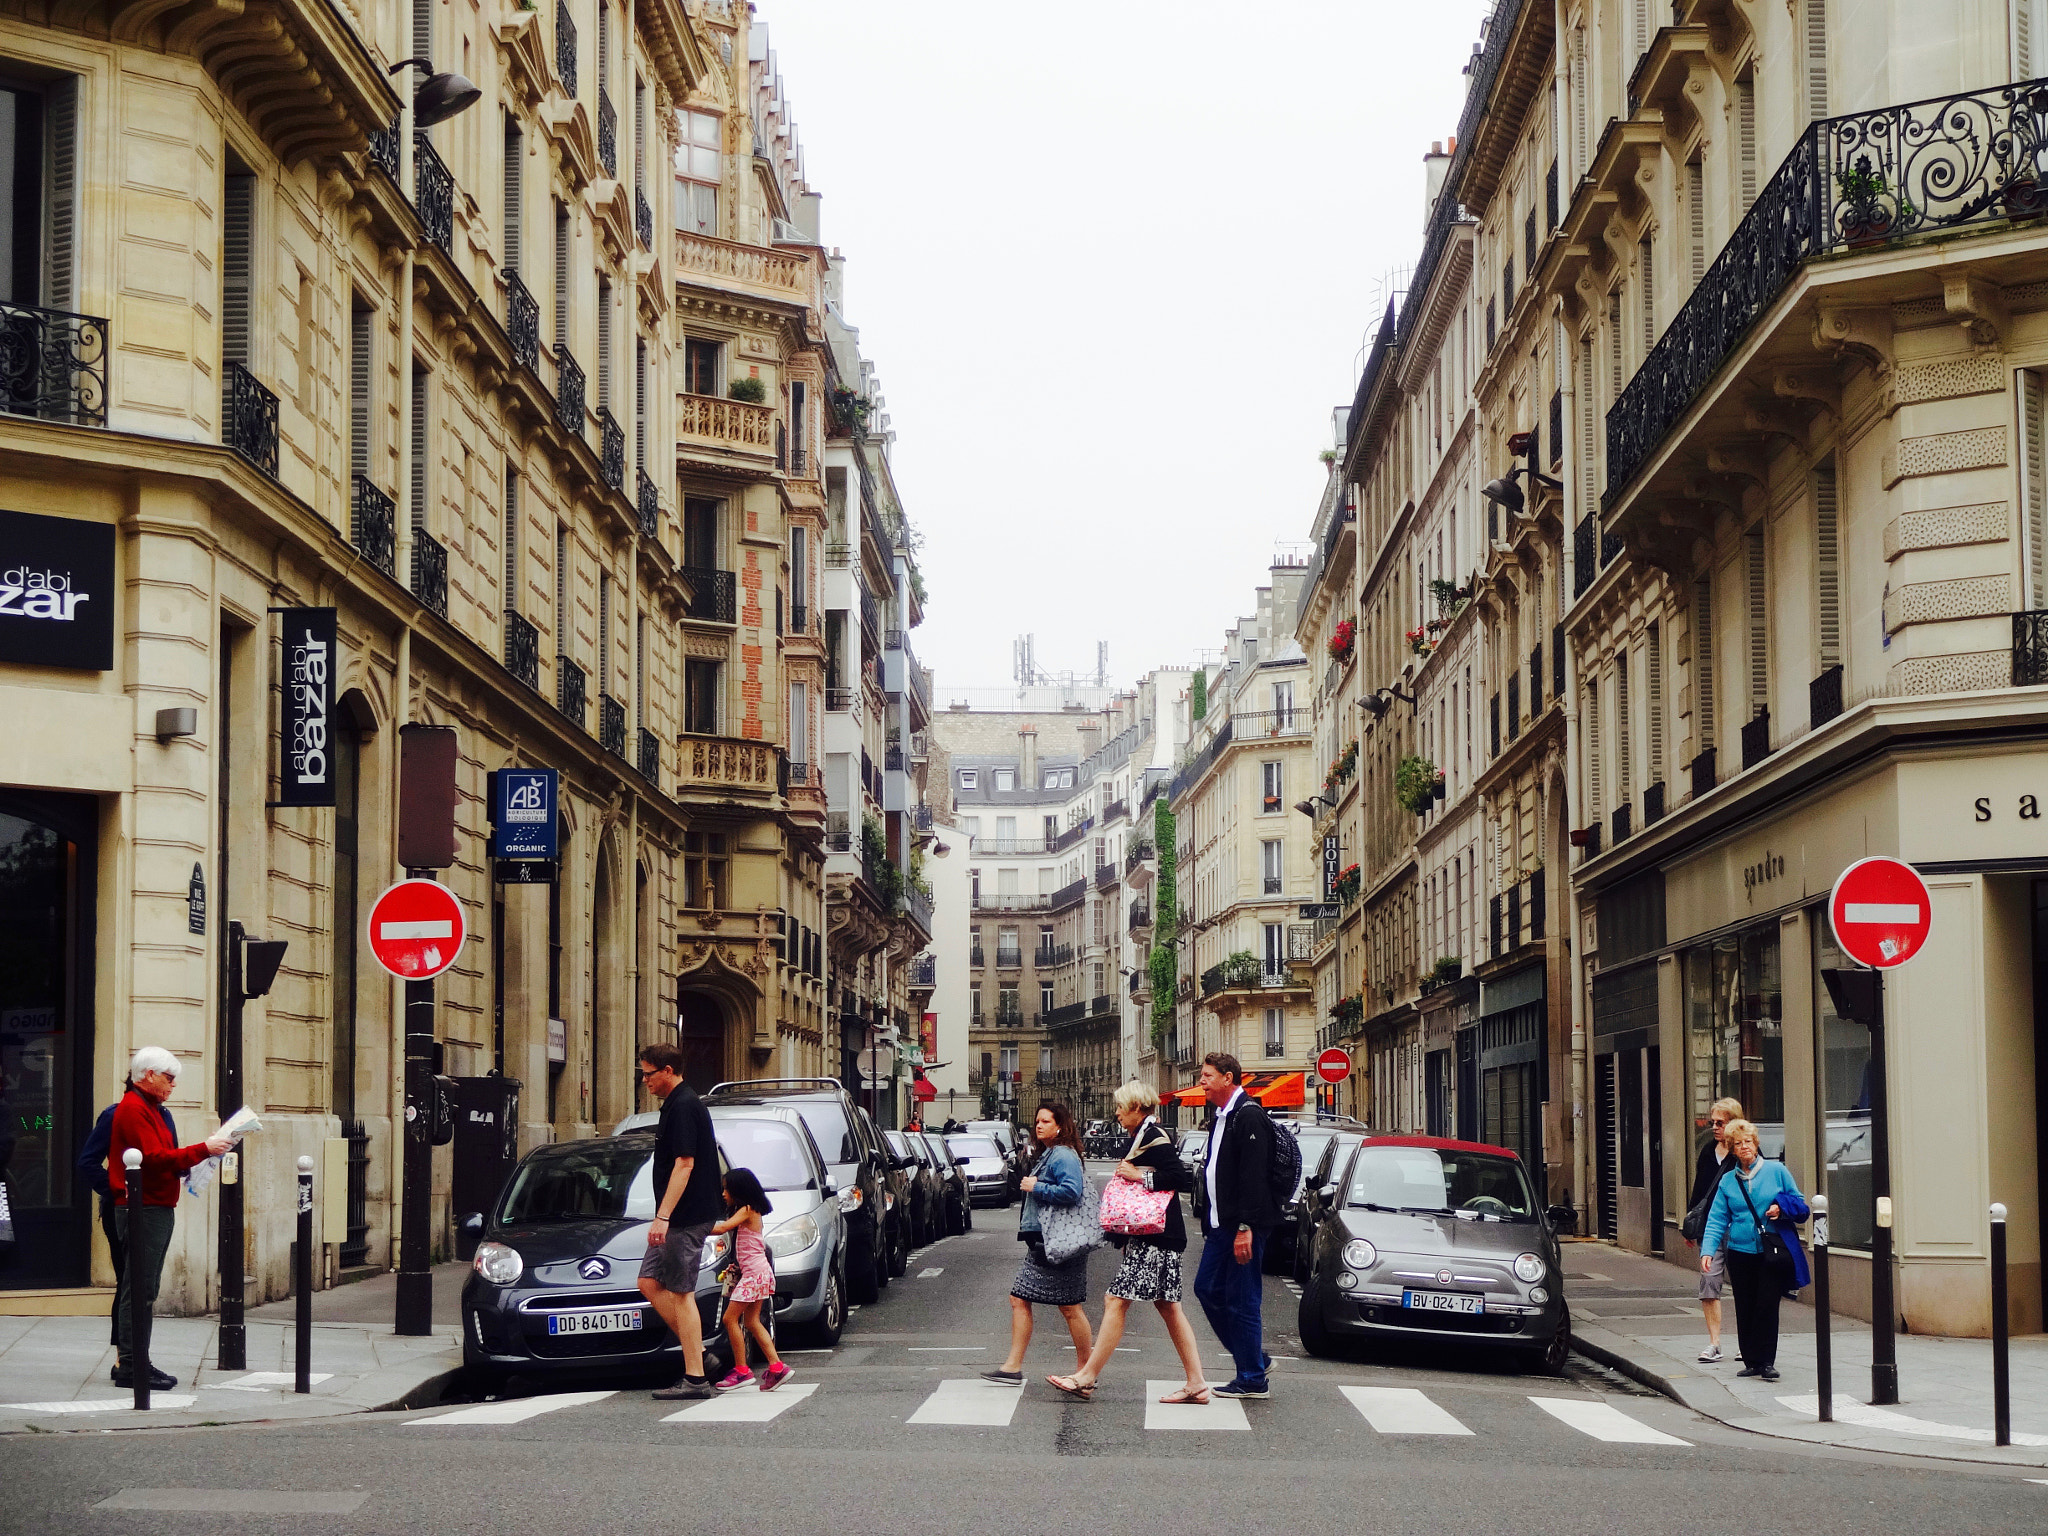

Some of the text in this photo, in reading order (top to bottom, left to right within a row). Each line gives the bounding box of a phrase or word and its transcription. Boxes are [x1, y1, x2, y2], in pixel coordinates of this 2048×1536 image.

[4, 565, 71, 592] d'abi
[290, 645, 307, 770] abou d'abi
[297, 629, 327, 784] bazar
[510, 785, 541, 808] AB
[505, 844, 547, 852] ORGANIC
[1325, 837, 1337, 895] HOTEL
[1744, 850, 1784, 887] sandro
[633, 1320, 641, 1328] 92
